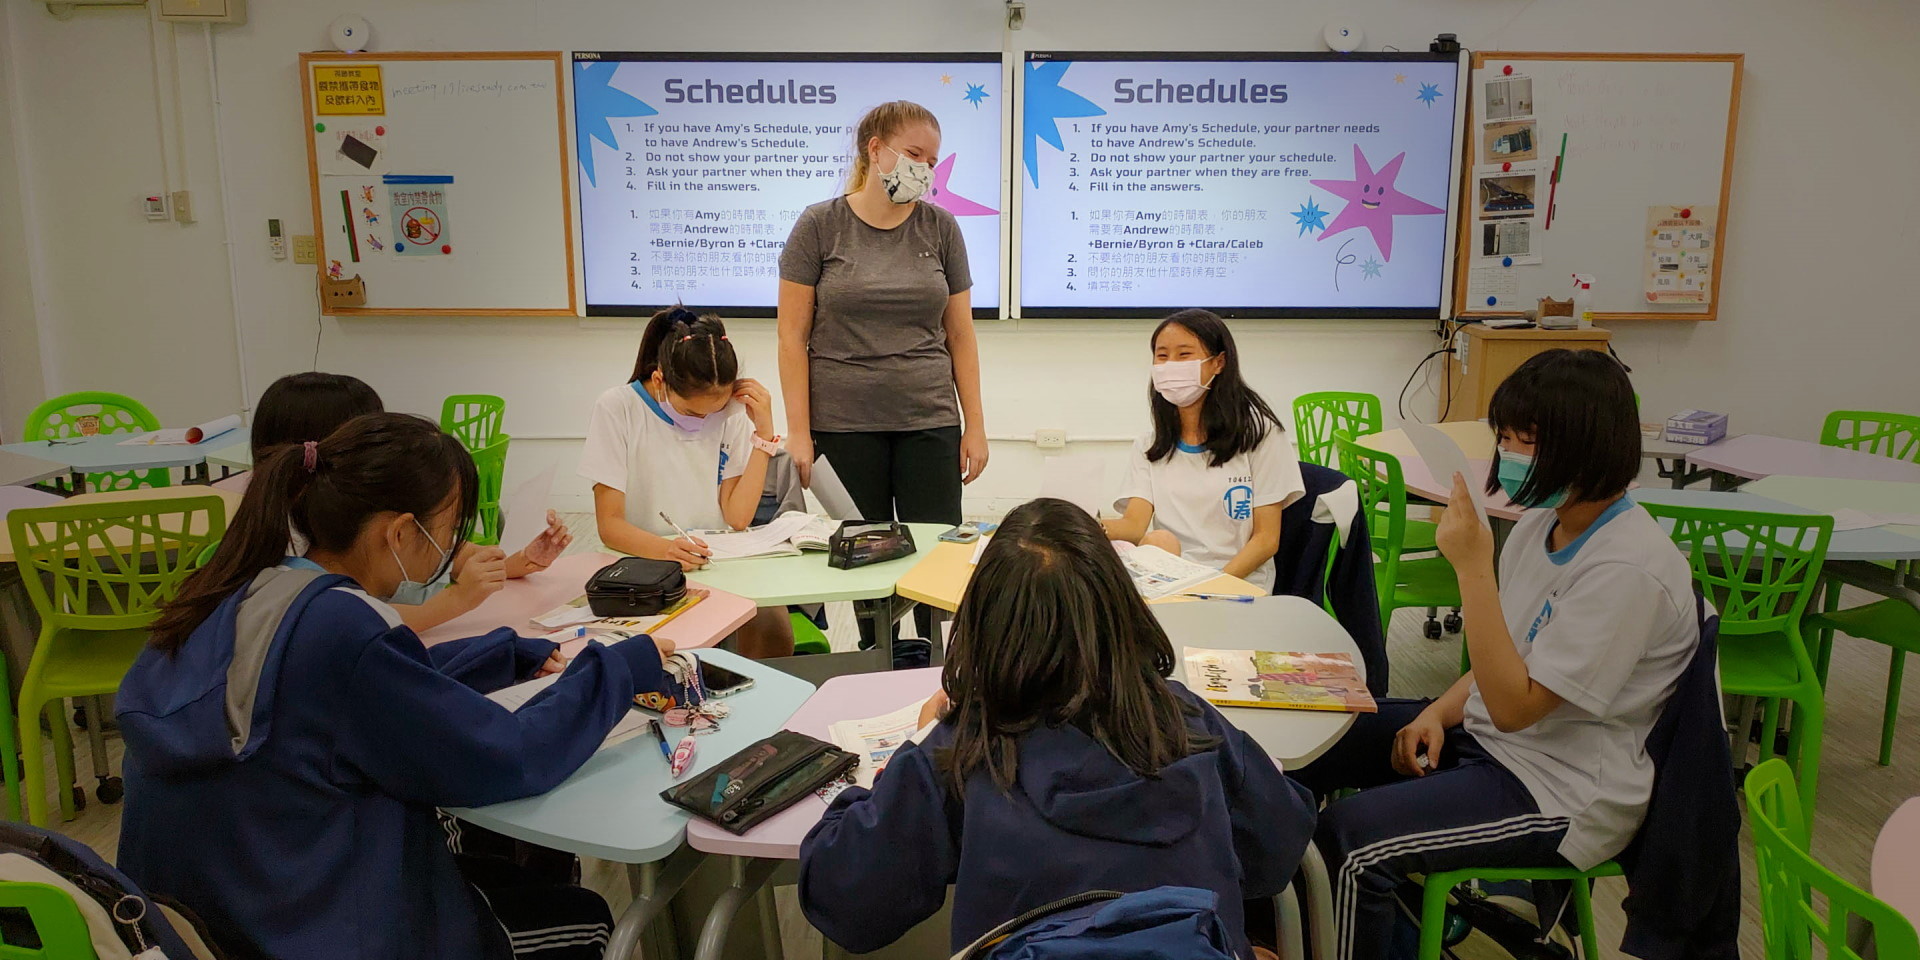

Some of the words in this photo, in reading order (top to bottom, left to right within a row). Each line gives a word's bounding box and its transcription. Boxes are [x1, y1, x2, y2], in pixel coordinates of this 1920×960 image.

[574, 52, 601, 60] PERSONA
[664, 78, 837, 104] Schedules
[1114, 78, 1288, 104] Schedules
[626, 123, 634, 132] 1.
[644, 123, 655, 133] If
[658, 125, 680, 135] you
[683, 123, 711, 133] have
[715, 123, 750, 136] Amy's
[753, 123, 812, 135] Schedule,
[815, 125, 843, 136] your
[1072, 123, 1080, 133] 1.
[1091, 123, 1102, 133] If
[1105, 125, 1127, 135] you
[1130, 123, 1159, 133] have
[1162, 123, 1198, 135] Amy's
[1202, 123, 1260, 134] Schedule,
[1264, 125, 1291, 135] your
[1295, 124, 1341, 135] partner
[1343, 123, 1380, 133] needs
[645, 138, 657, 148] to
[661, 138, 689, 148] have
[692, 138, 748, 148] Andrew's
[751, 138, 809, 149] Schedule.
[1091, 139, 1103, 148] to
[1107, 138, 1135, 148] have
[1138, 138, 1195, 148] Andrew's
[1198, 138, 1256, 147] Schedule.
[625, 152, 636, 162] 2.
[645, 152, 662, 162] Do
[665, 153, 685, 162] not
[688, 152, 720, 162] show
[723, 154, 751, 164] your
[754, 153, 799, 164] partner
[802, 155, 829, 164] your
[1069, 152, 1080, 162] 2.
[1090, 152, 1106, 162] Do
[1110, 153, 1130, 162] not
[1133, 152, 1166, 162] show
[1169, 154, 1196, 164] your
[1199, 153, 1245, 164] partner
[1249, 154, 1276, 164] your
[1279, 153, 1337, 162] schedule.
[625, 166, 636, 176] 3.
[646, 166, 668, 176] Ask
[672, 168, 699, 178] your
[702, 167, 747, 178] partner
[750, 167, 783, 177] when
[786, 167, 812, 179] they
[815, 168, 835, 178] are
[1069, 167, 1079, 177] 3.
[1090, 167, 1112, 177] Ask
[1116, 168, 1143, 178] your
[1146, 167, 1192, 178] partner
[1195, 167, 1228, 177] when
[1231, 167, 1258, 178] they
[1261, 169, 1280, 177] are
[1284, 167, 1312, 176] free.
[626, 181, 637, 190] 4.
[647, 181, 666, 190] Fill
[669, 181, 681, 190] in
[684, 181, 704, 191] the
[707, 183, 760, 191] answers.
[1068, 181, 1079, 191] 4.
[1089, 182, 1108, 191] Fill
[1112, 181, 1123, 191] in
[1127, 182, 1147, 191] the
[1150, 183, 1204, 191] answers.
[630, 210, 638, 219] 1.
[1071, 211, 1078, 220] 1.
[649, 238, 735, 249] +Bernie/Byron
[738, 239, 746, 248] &
[1088, 239, 1174, 250] +Bernie/Byron
[1177, 240, 1185, 248] &
[1189, 239, 1264, 248] +Clara/Caleb
[630, 252, 640, 261] 2.
[1067, 253, 1077, 262] 2.
[630, 266, 641, 275] 3.
[1066, 267, 1077, 276] 3.
[631, 280, 642, 290] 4.
[1066, 281, 1076, 291] 4.
